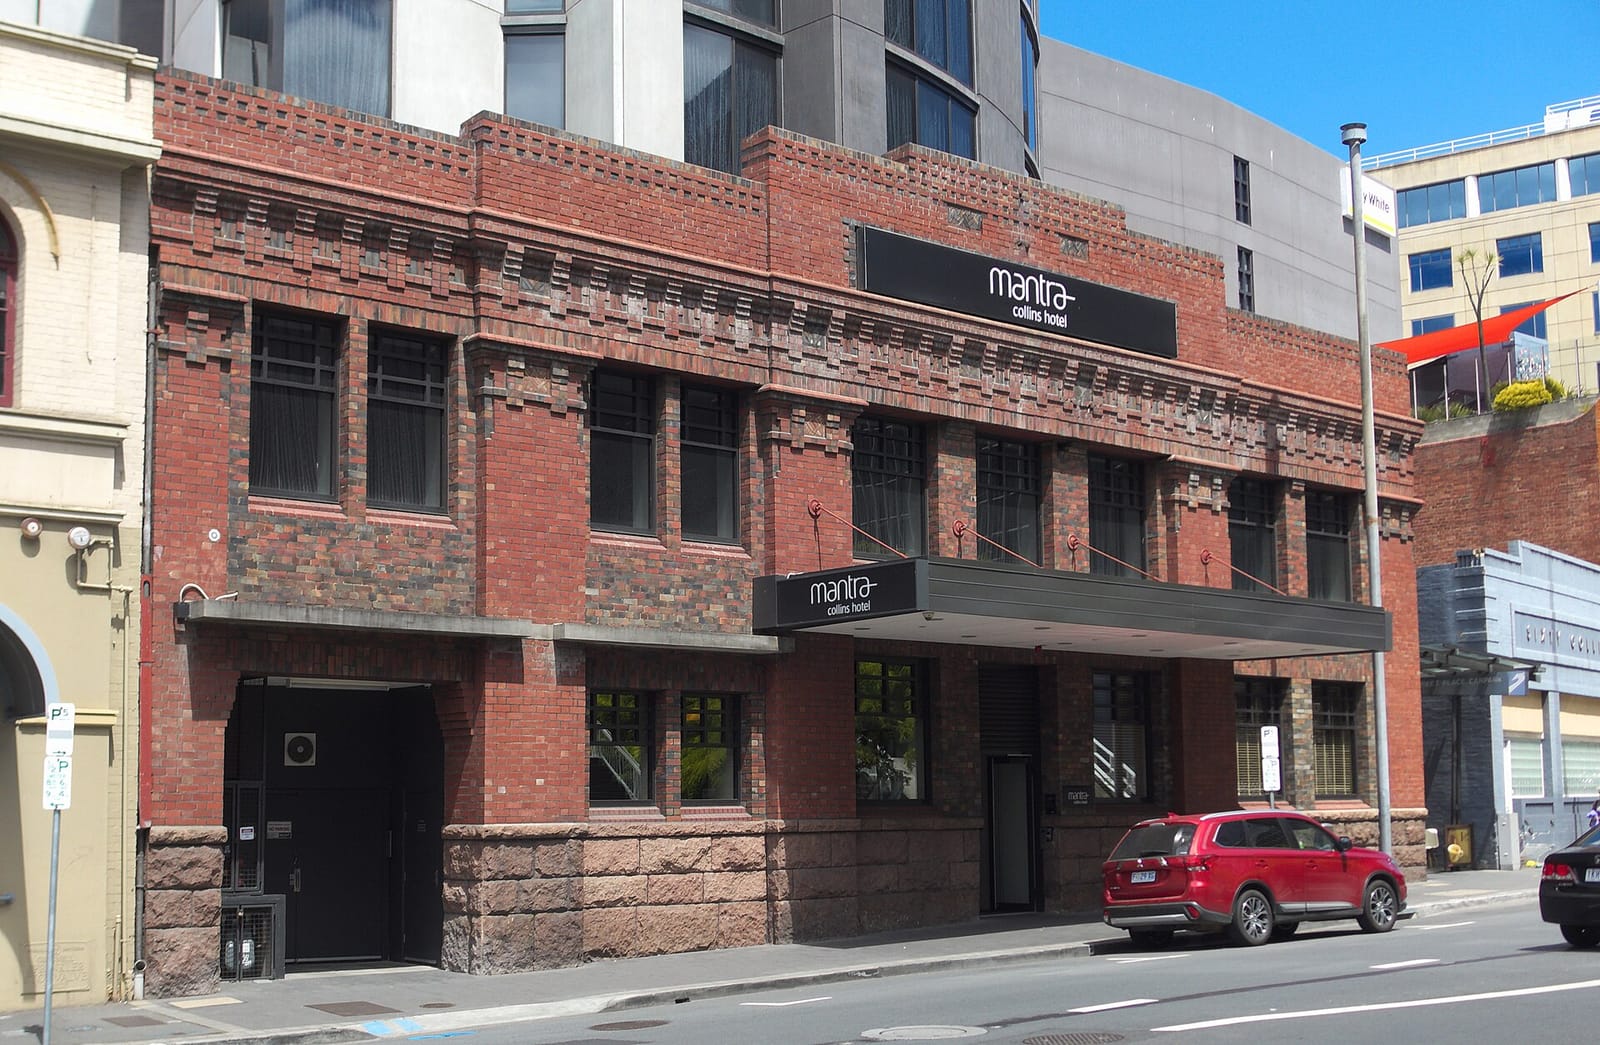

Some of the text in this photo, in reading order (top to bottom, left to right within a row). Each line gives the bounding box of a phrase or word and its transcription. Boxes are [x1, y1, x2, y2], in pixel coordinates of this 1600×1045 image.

[1369, 192, 1390, 213] White
[990, 267, 1076, 310] mantra
[1012, 305, 1068, 328] collins hotel
[810, 575, 878, 605] mantra
[827, 600, 871, 616] collins hotel
